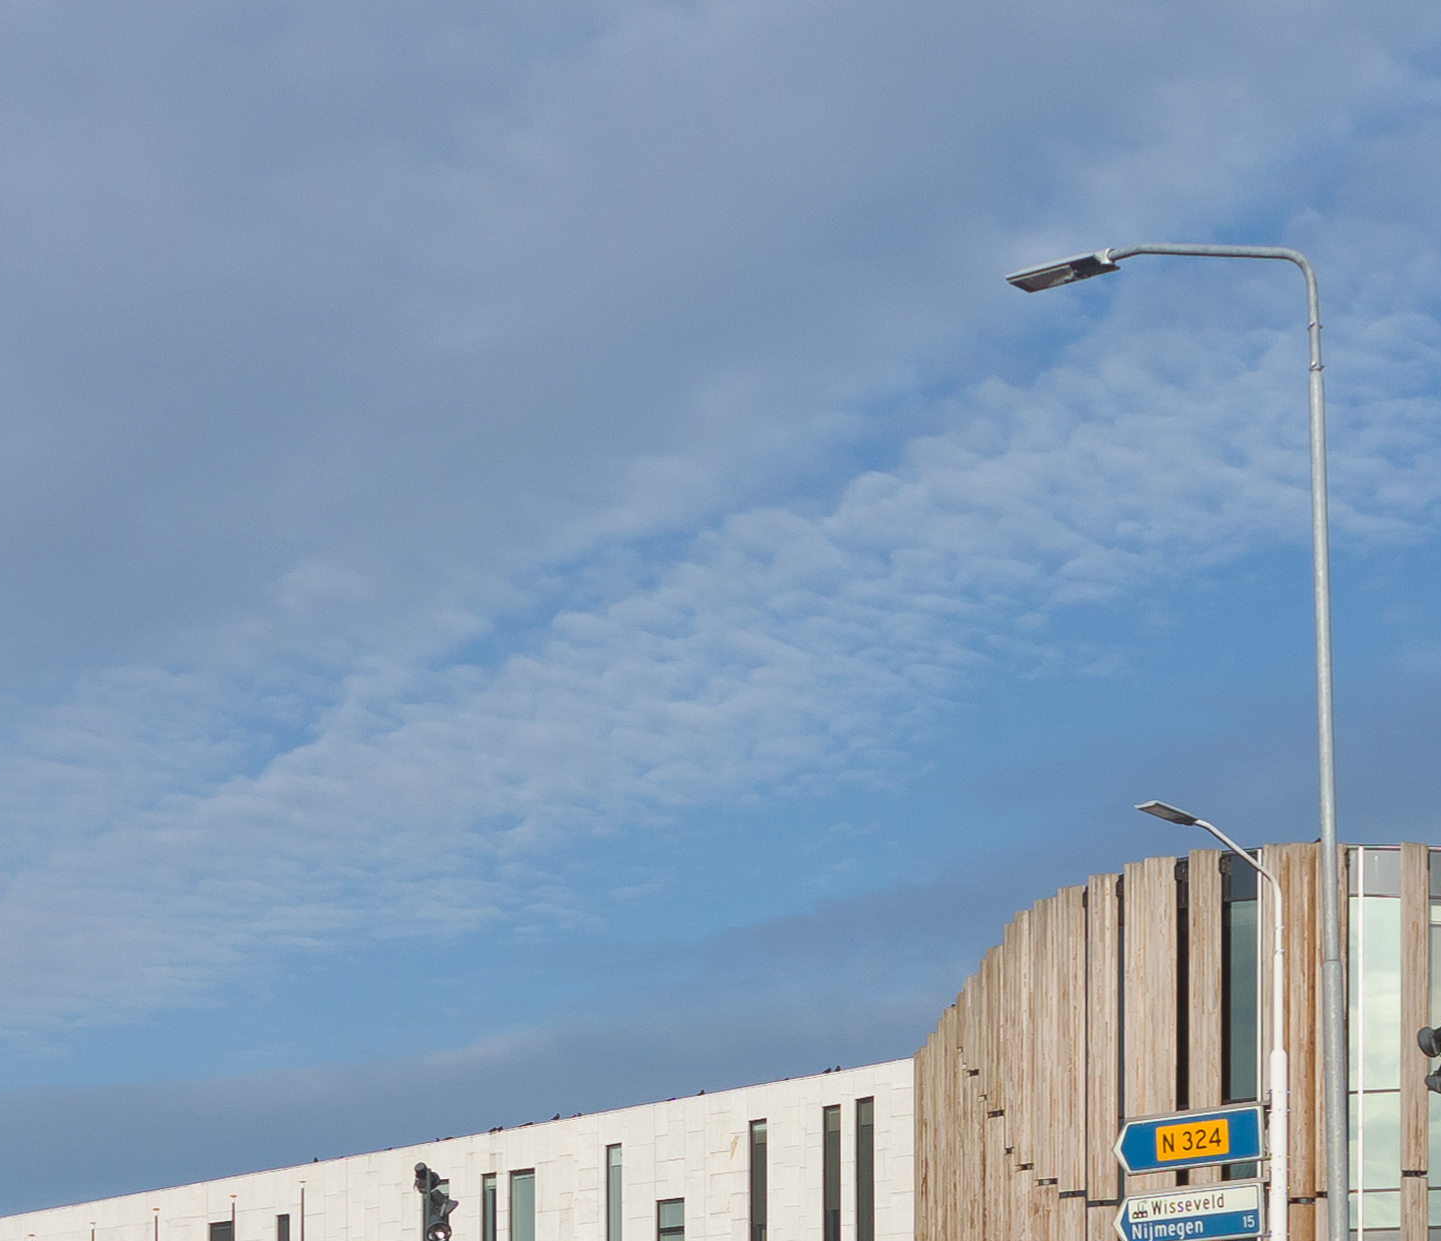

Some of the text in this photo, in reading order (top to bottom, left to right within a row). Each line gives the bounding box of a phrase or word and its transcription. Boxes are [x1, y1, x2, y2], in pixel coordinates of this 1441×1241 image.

[1163, 1127, 1222, 1154] N 324
[1151, 1193, 1225, 1216] Wisseveld
[1242, 1214, 1256, 1229] 15
